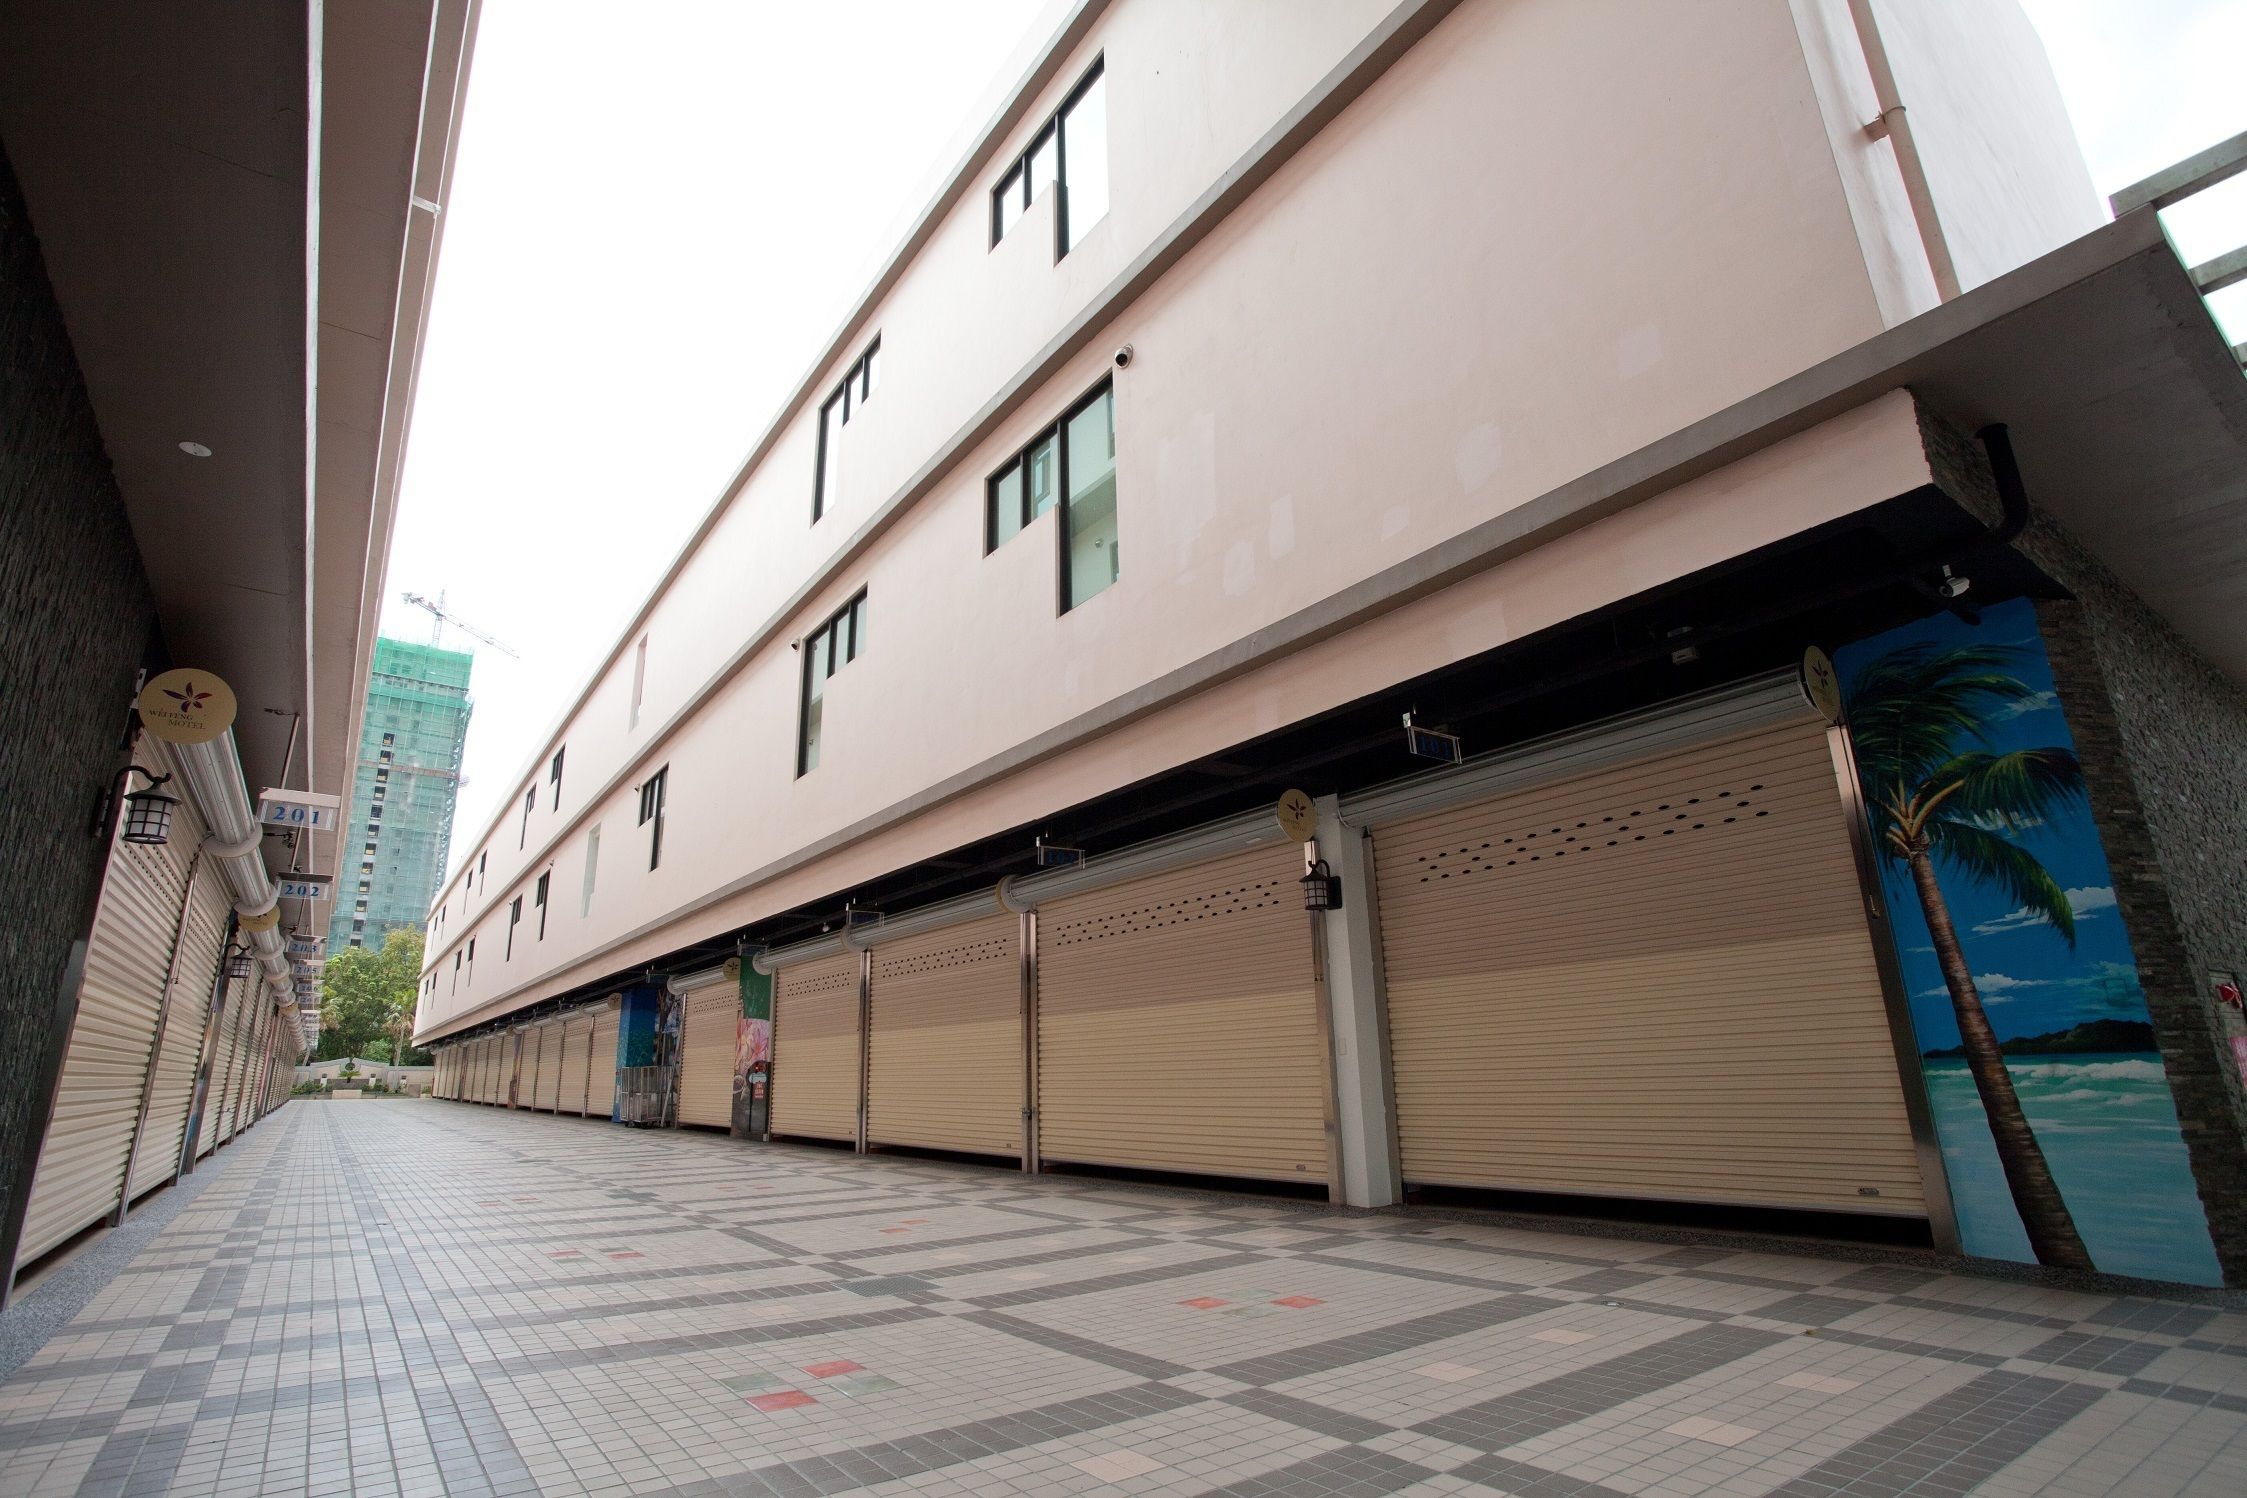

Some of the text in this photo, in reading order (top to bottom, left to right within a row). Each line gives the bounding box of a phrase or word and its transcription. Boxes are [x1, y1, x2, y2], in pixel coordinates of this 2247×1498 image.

[168, 719, 206, 730] MOTEL
[273, 806, 320, 825] 201
[285, 884, 319, 897] 202
[292, 943, 317, 952] 203
[296, 966, 318, 974] 205
